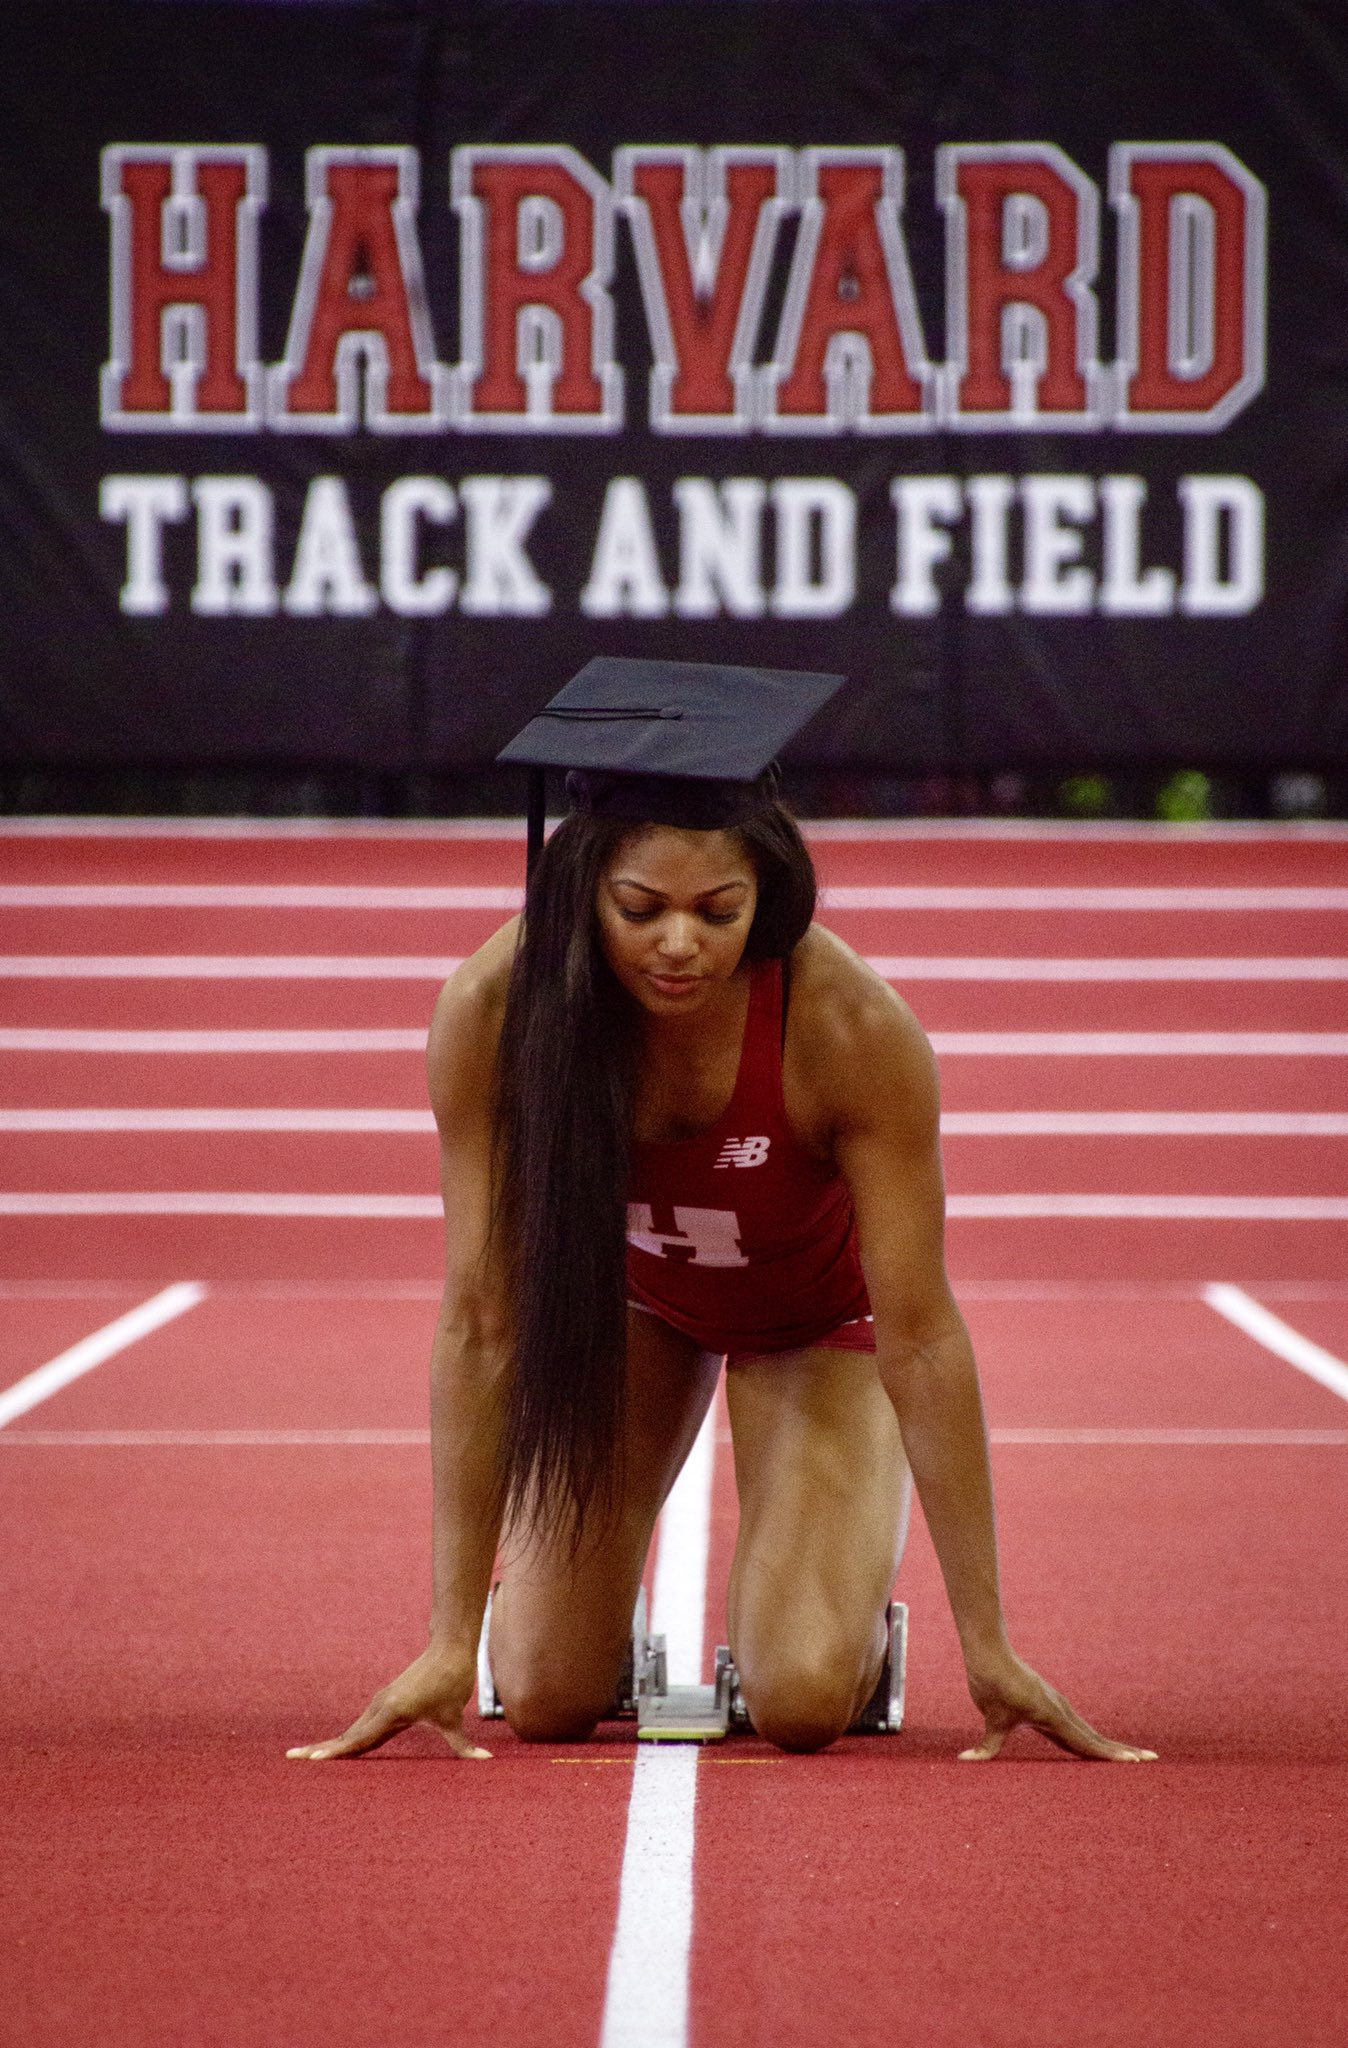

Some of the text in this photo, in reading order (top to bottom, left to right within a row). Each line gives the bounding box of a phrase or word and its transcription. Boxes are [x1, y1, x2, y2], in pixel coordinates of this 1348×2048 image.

[100, 142, 1268, 434] HARVARD
[100, 473, 1266, 618] TRACK AND FIELD
[713, 1136, 771, 1169] NB
